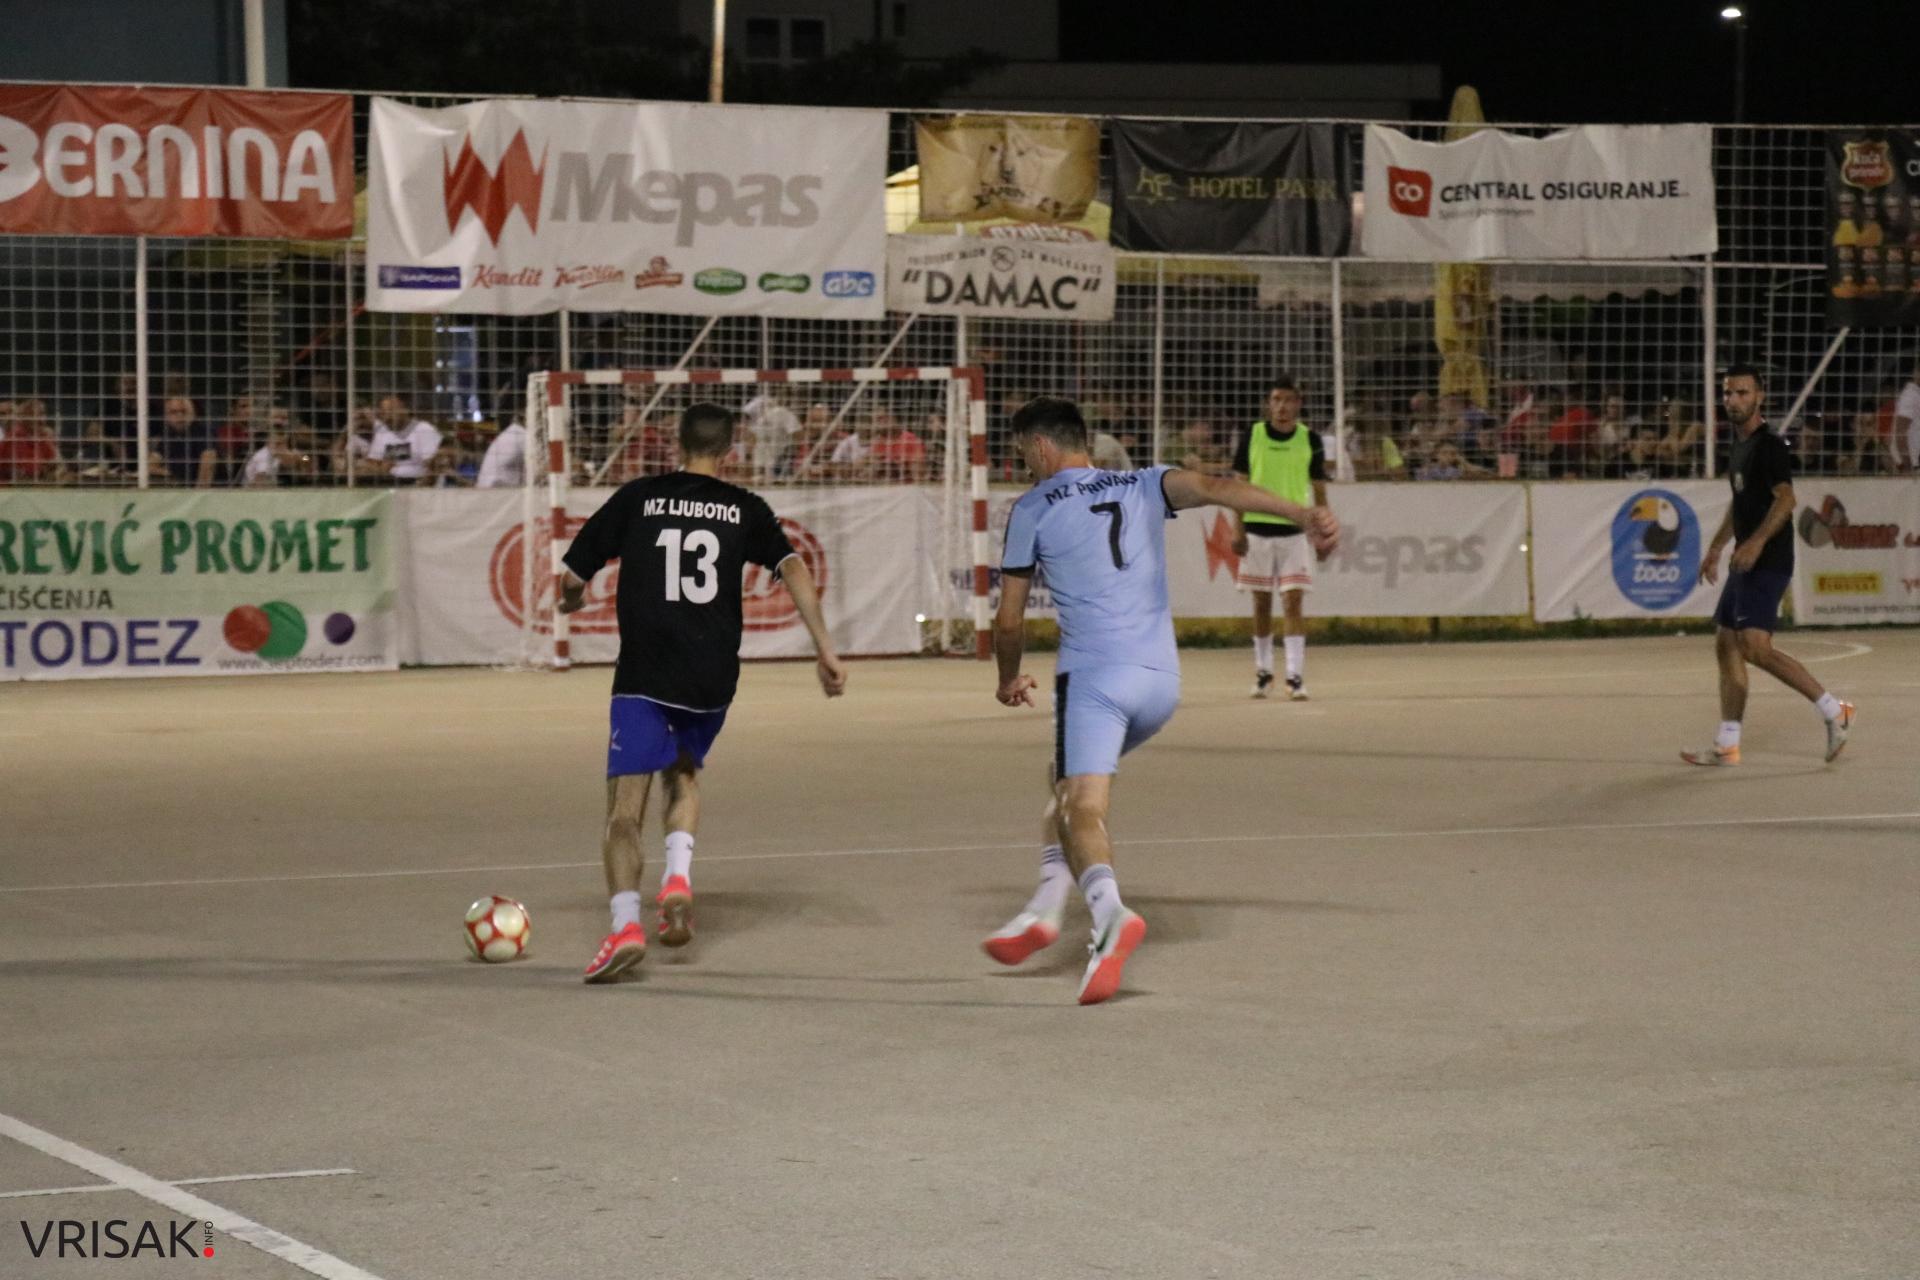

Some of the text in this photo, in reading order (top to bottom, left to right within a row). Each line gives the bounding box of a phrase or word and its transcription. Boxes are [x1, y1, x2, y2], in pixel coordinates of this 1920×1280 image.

[0, 113, 336, 203] BERNINA
[549, 152, 822, 248] Mepas
[1188, 175, 1269, 199] HOTEL
[1440, 179, 1680, 204] CENTRAL OSIGURANJE
[825, 271, 874, 294] abc
[643, 498, 741, 525] MZ LJUBOTIĆI
[1044, 484, 1073, 506] MZ
[159, 517, 378, 574] PROMET
[1089, 501, 1126, 571] 7
[655, 528, 720, 604] 13
[0, 619, 200, 668] TODEZ
